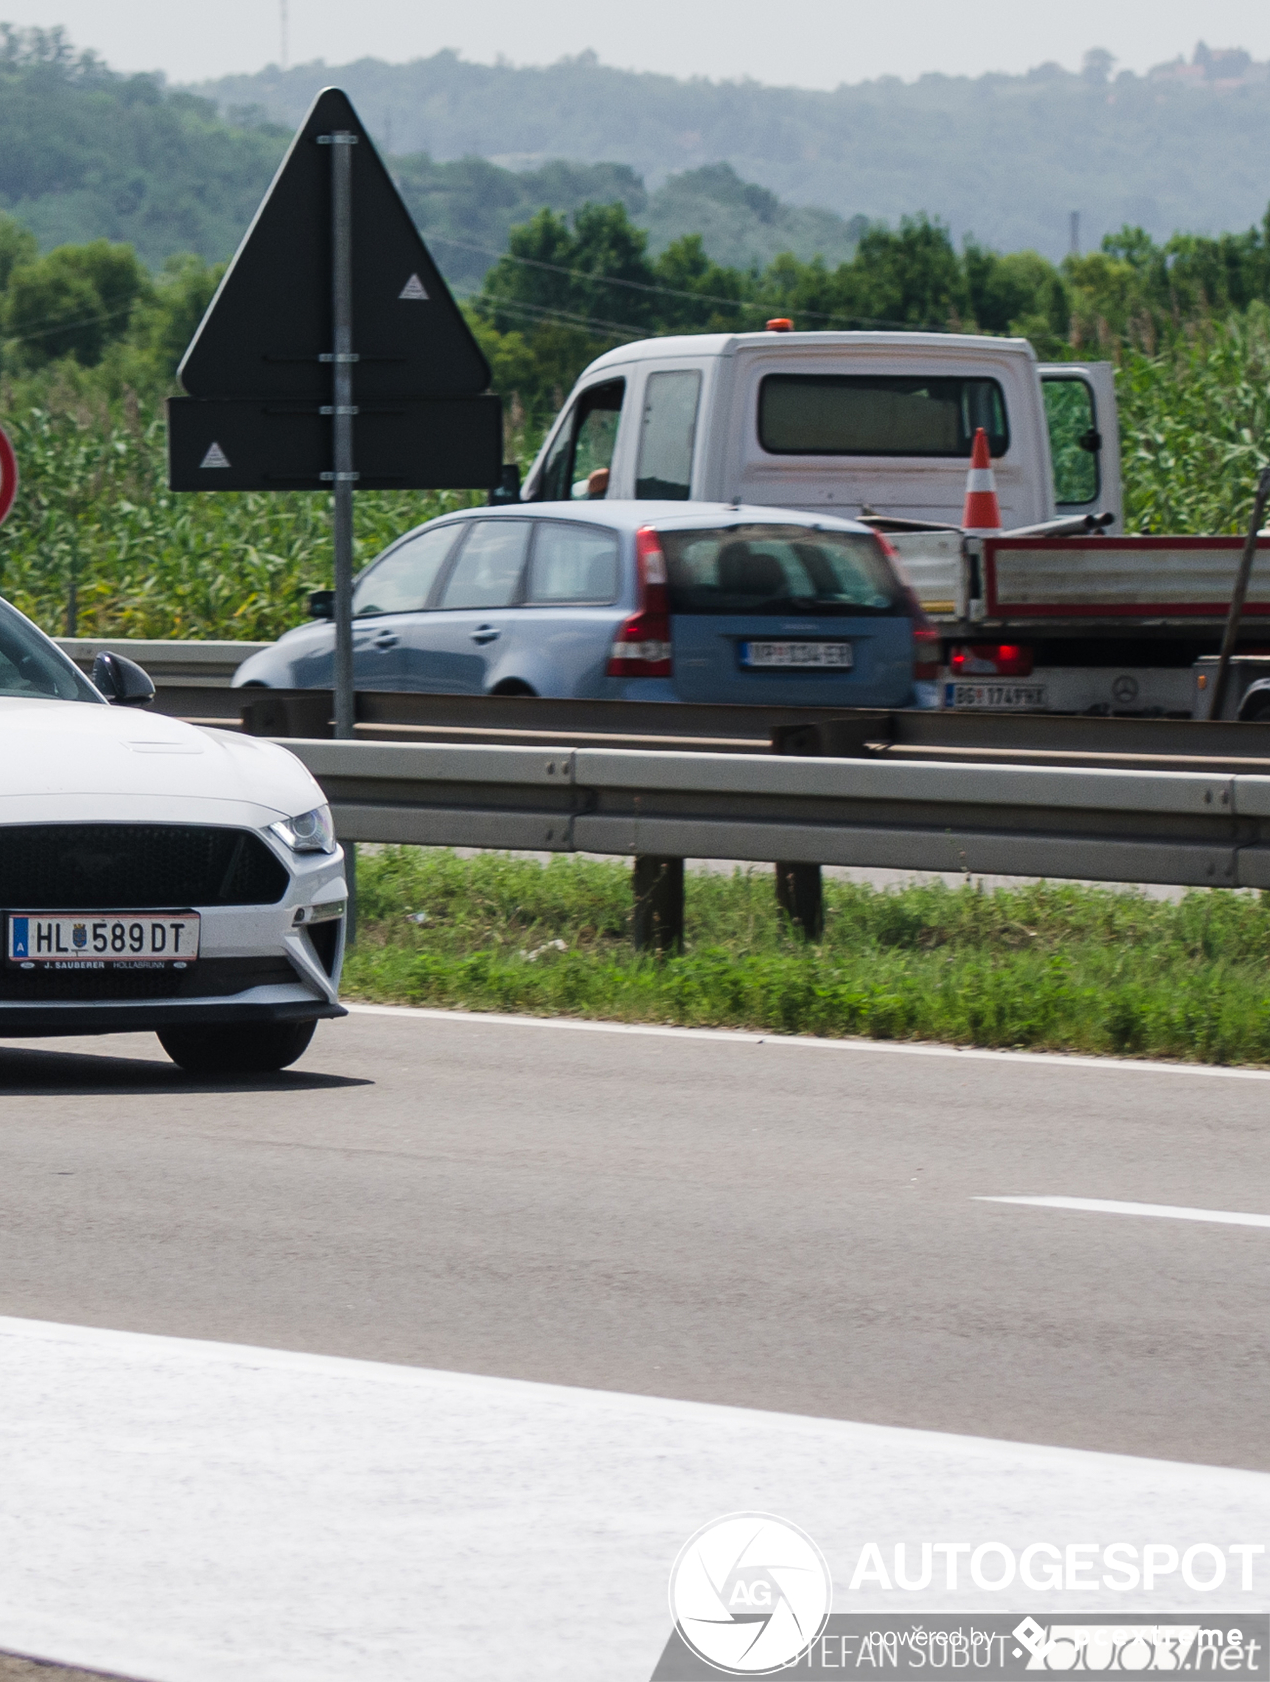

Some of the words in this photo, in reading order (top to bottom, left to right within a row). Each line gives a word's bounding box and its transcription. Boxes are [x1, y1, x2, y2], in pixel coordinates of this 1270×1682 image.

[36, 922, 69, 953] HL
[92, 922, 144, 952] 589
[150, 922, 185, 953] DT
[55, 961, 105, 969] SAUBERER
[113, 961, 165, 969] HOLLABRUNN
